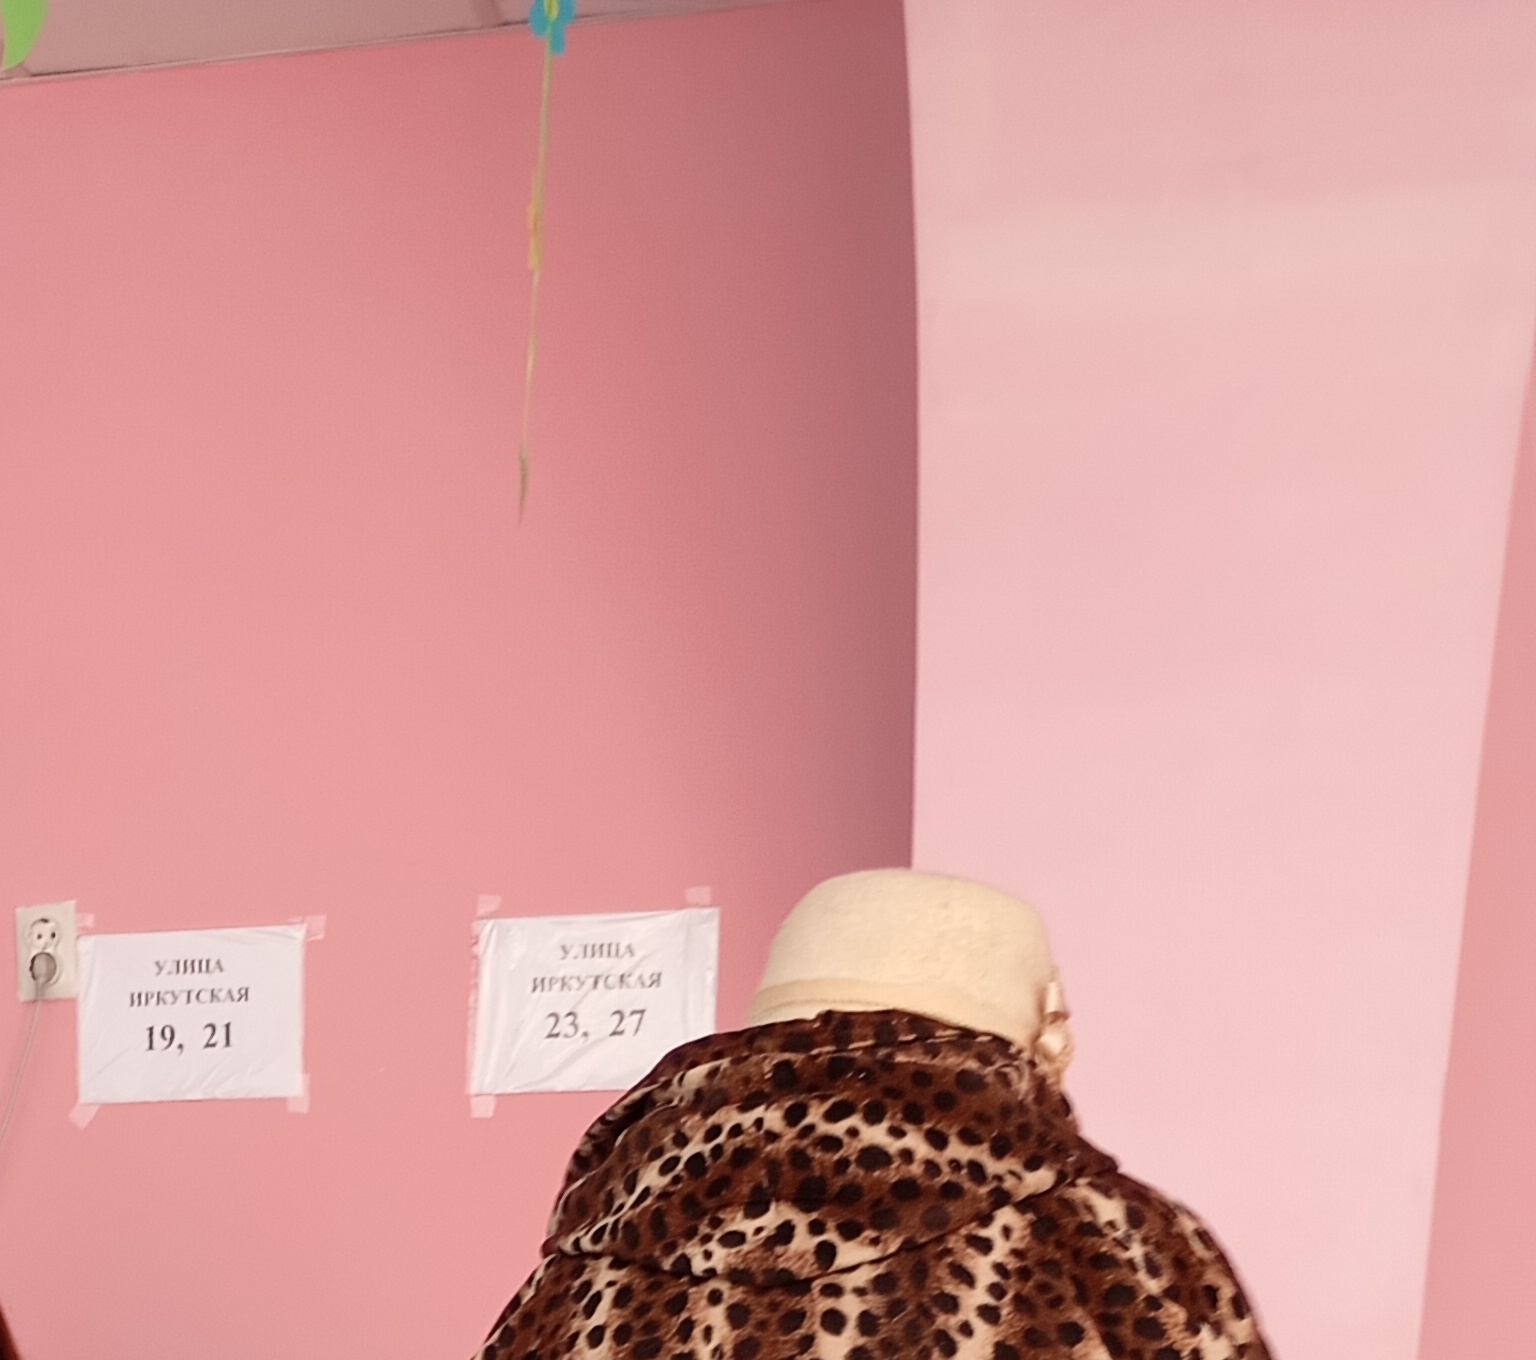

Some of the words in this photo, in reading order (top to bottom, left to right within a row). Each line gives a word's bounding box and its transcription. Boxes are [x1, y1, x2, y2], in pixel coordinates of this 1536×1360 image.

[560, 942, 635, 960] УЛИЦА
[154, 958, 224, 976] УЛИЦА
[531, 971, 663, 994] ИРКУТСКАЯ
[129, 986, 250, 1008] ИРКУТСКАЯ
[544, 1011, 590, 1043] 23,
[608, 1008, 647, 1038] 27
[145, 1024, 185, 1056] 19,
[202, 1021, 233, 1050] 21
